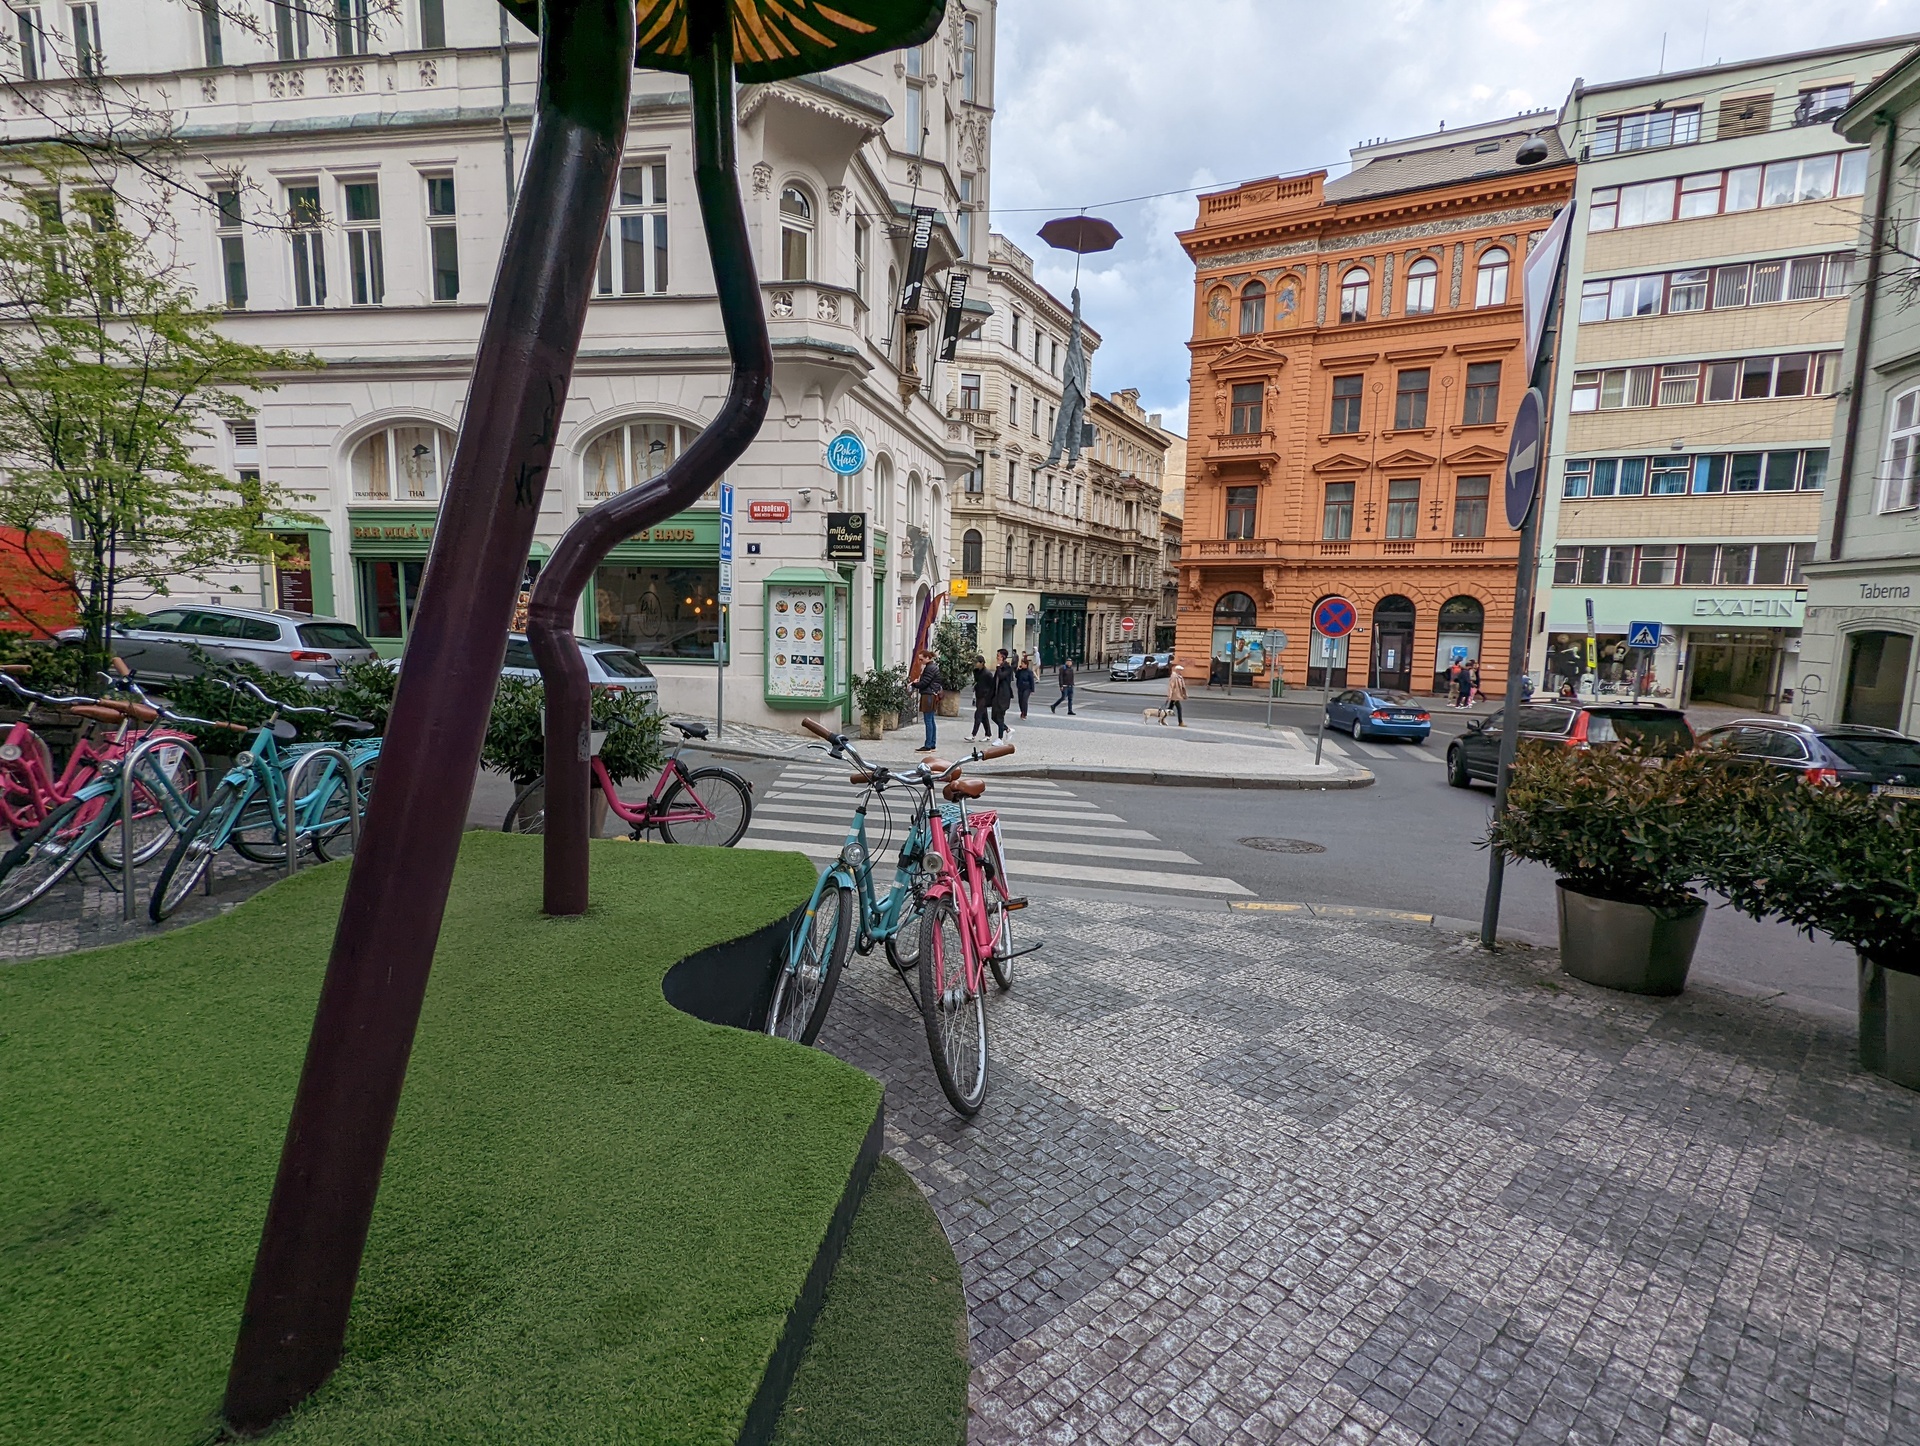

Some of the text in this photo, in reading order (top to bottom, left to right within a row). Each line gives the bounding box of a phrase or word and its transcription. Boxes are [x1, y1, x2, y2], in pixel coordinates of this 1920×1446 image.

[833, 442, 858, 460] Poke
[836, 453, 858, 467] Haus
[354, 527, 381, 538] BAR
[384, 524, 419, 539] MILÁ
[654, 529, 694, 541] HAUS
[1860, 583, 1910, 599] Taberna
